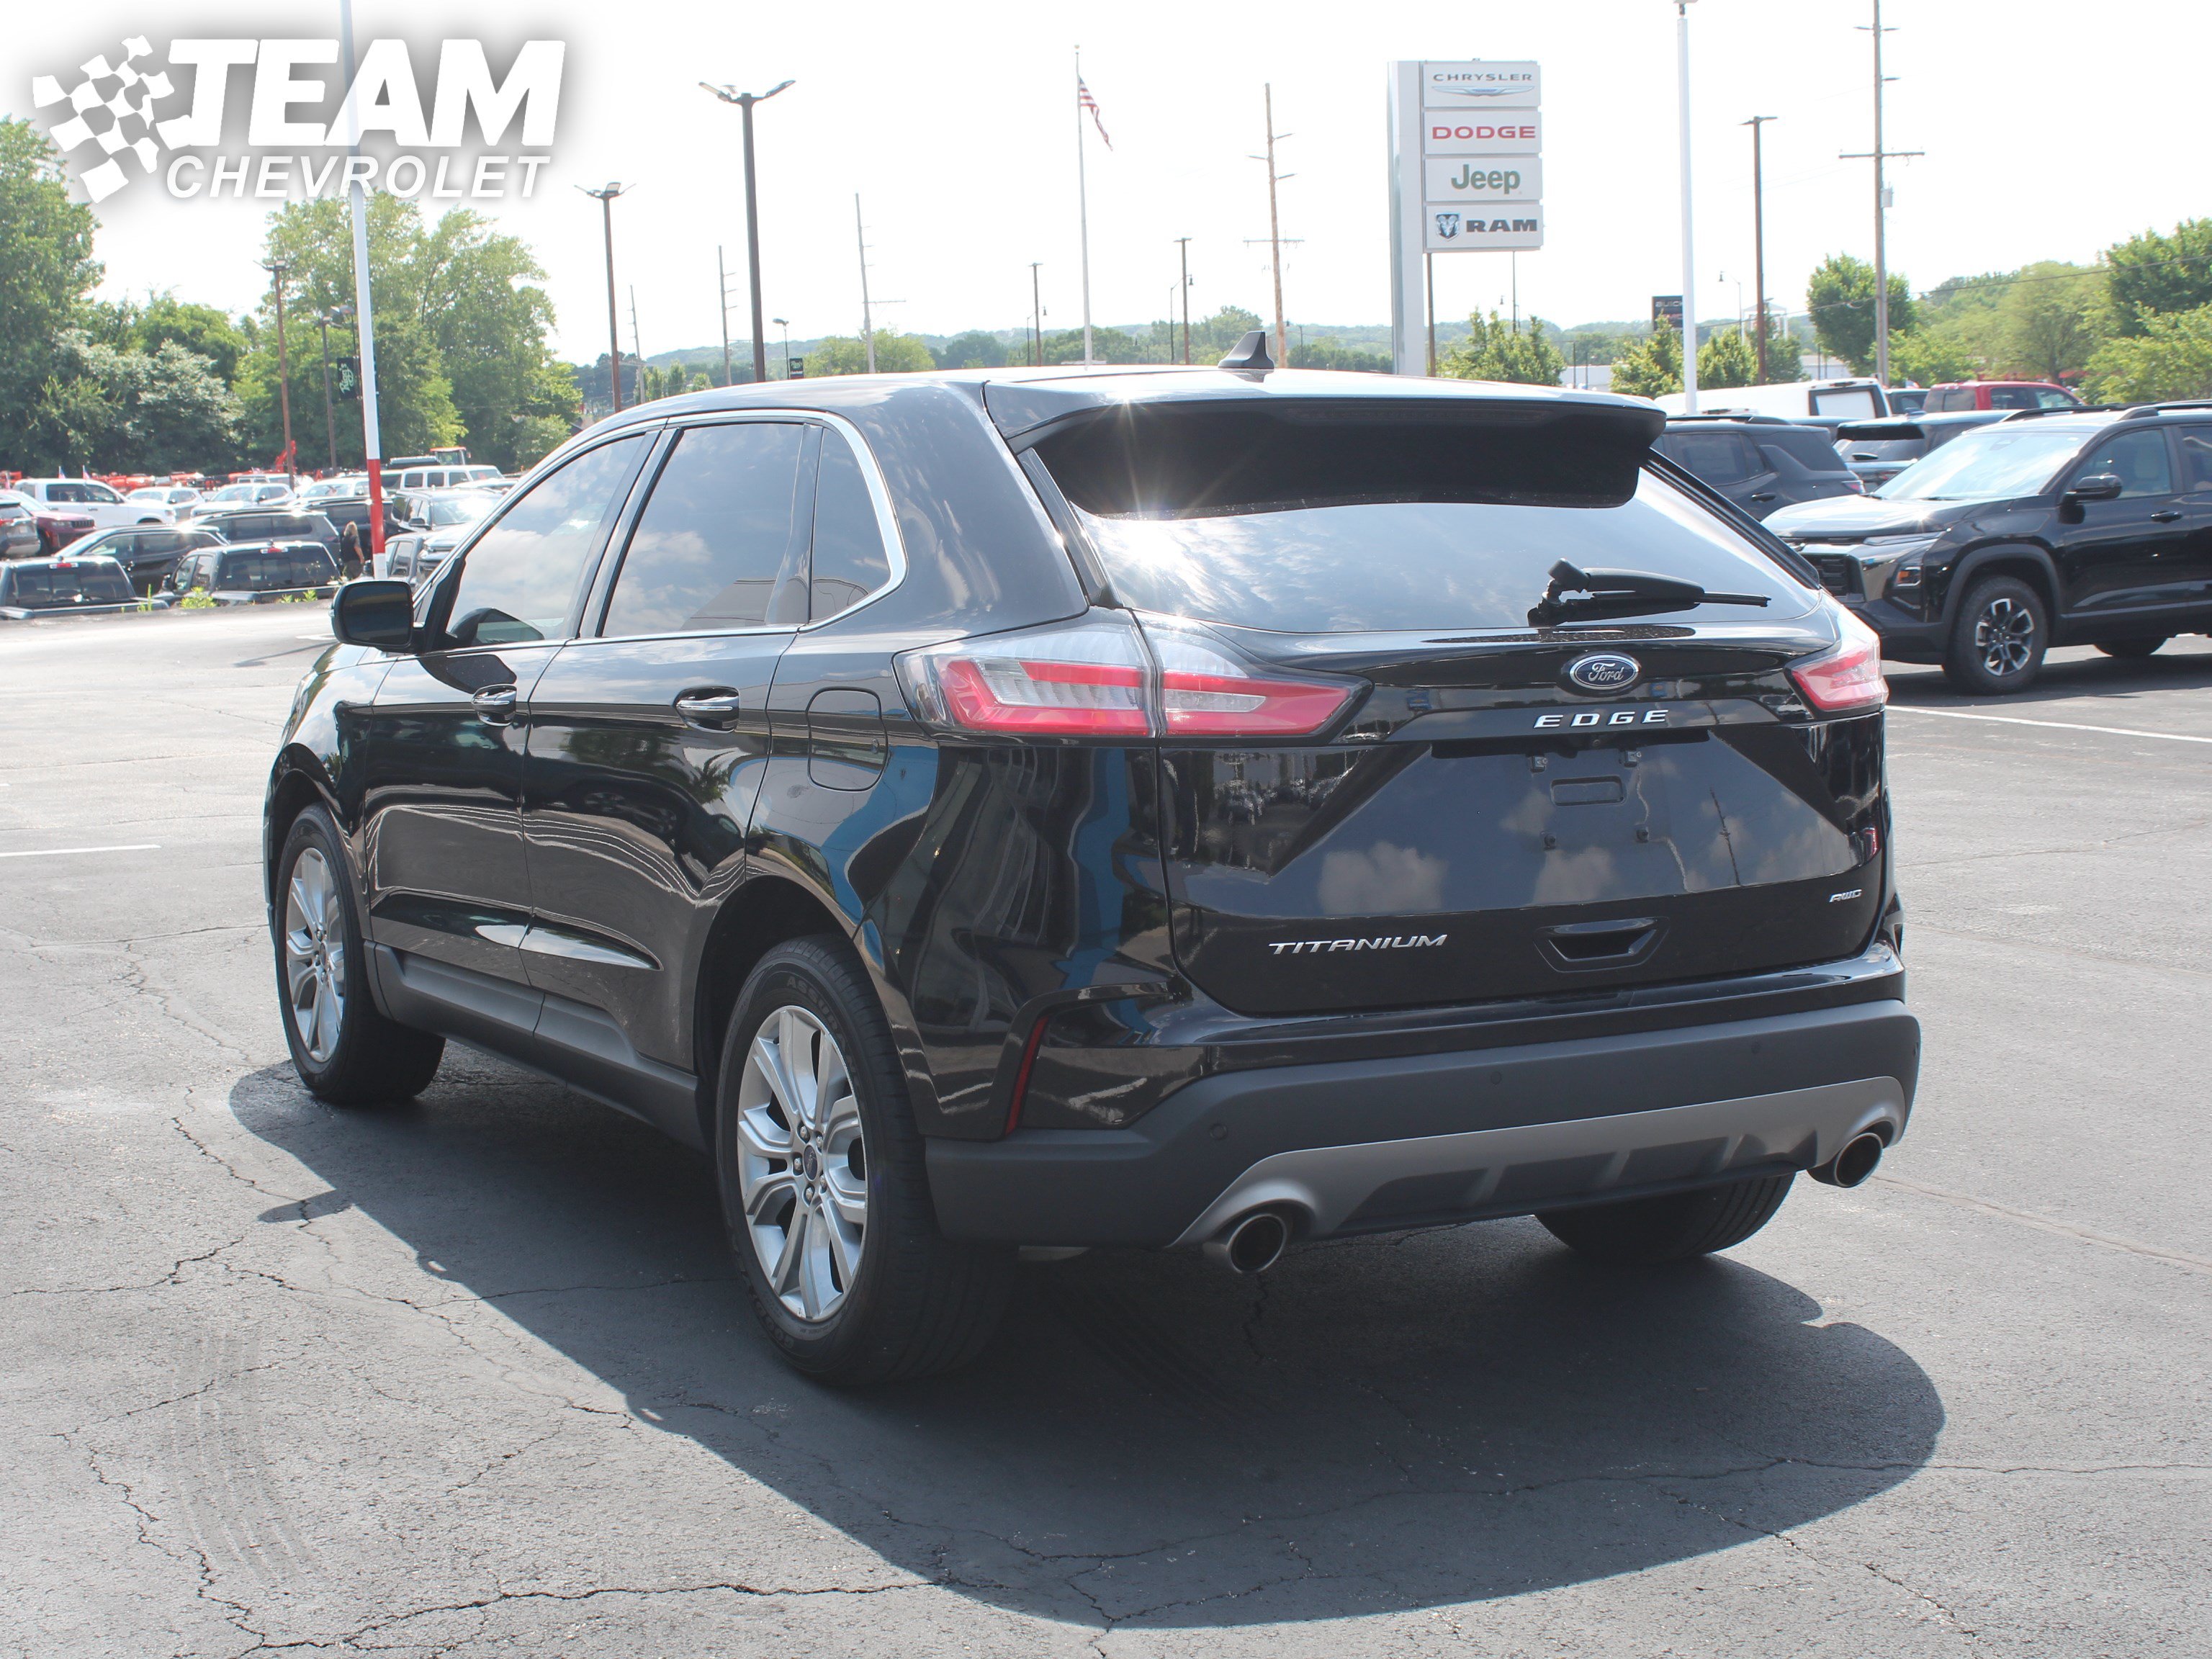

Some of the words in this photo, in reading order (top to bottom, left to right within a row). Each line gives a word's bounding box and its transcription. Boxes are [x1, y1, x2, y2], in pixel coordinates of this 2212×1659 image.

[1432, 126, 1536, 139] DODGE
[1451, 164, 1521, 194] Jeep
[1466, 220, 1537, 233] RAM
[1588, 662, 1624, 682] Ford
[1534, 709, 1669, 729] EDGE
[1269, 934, 1448, 955] TITANIUM
